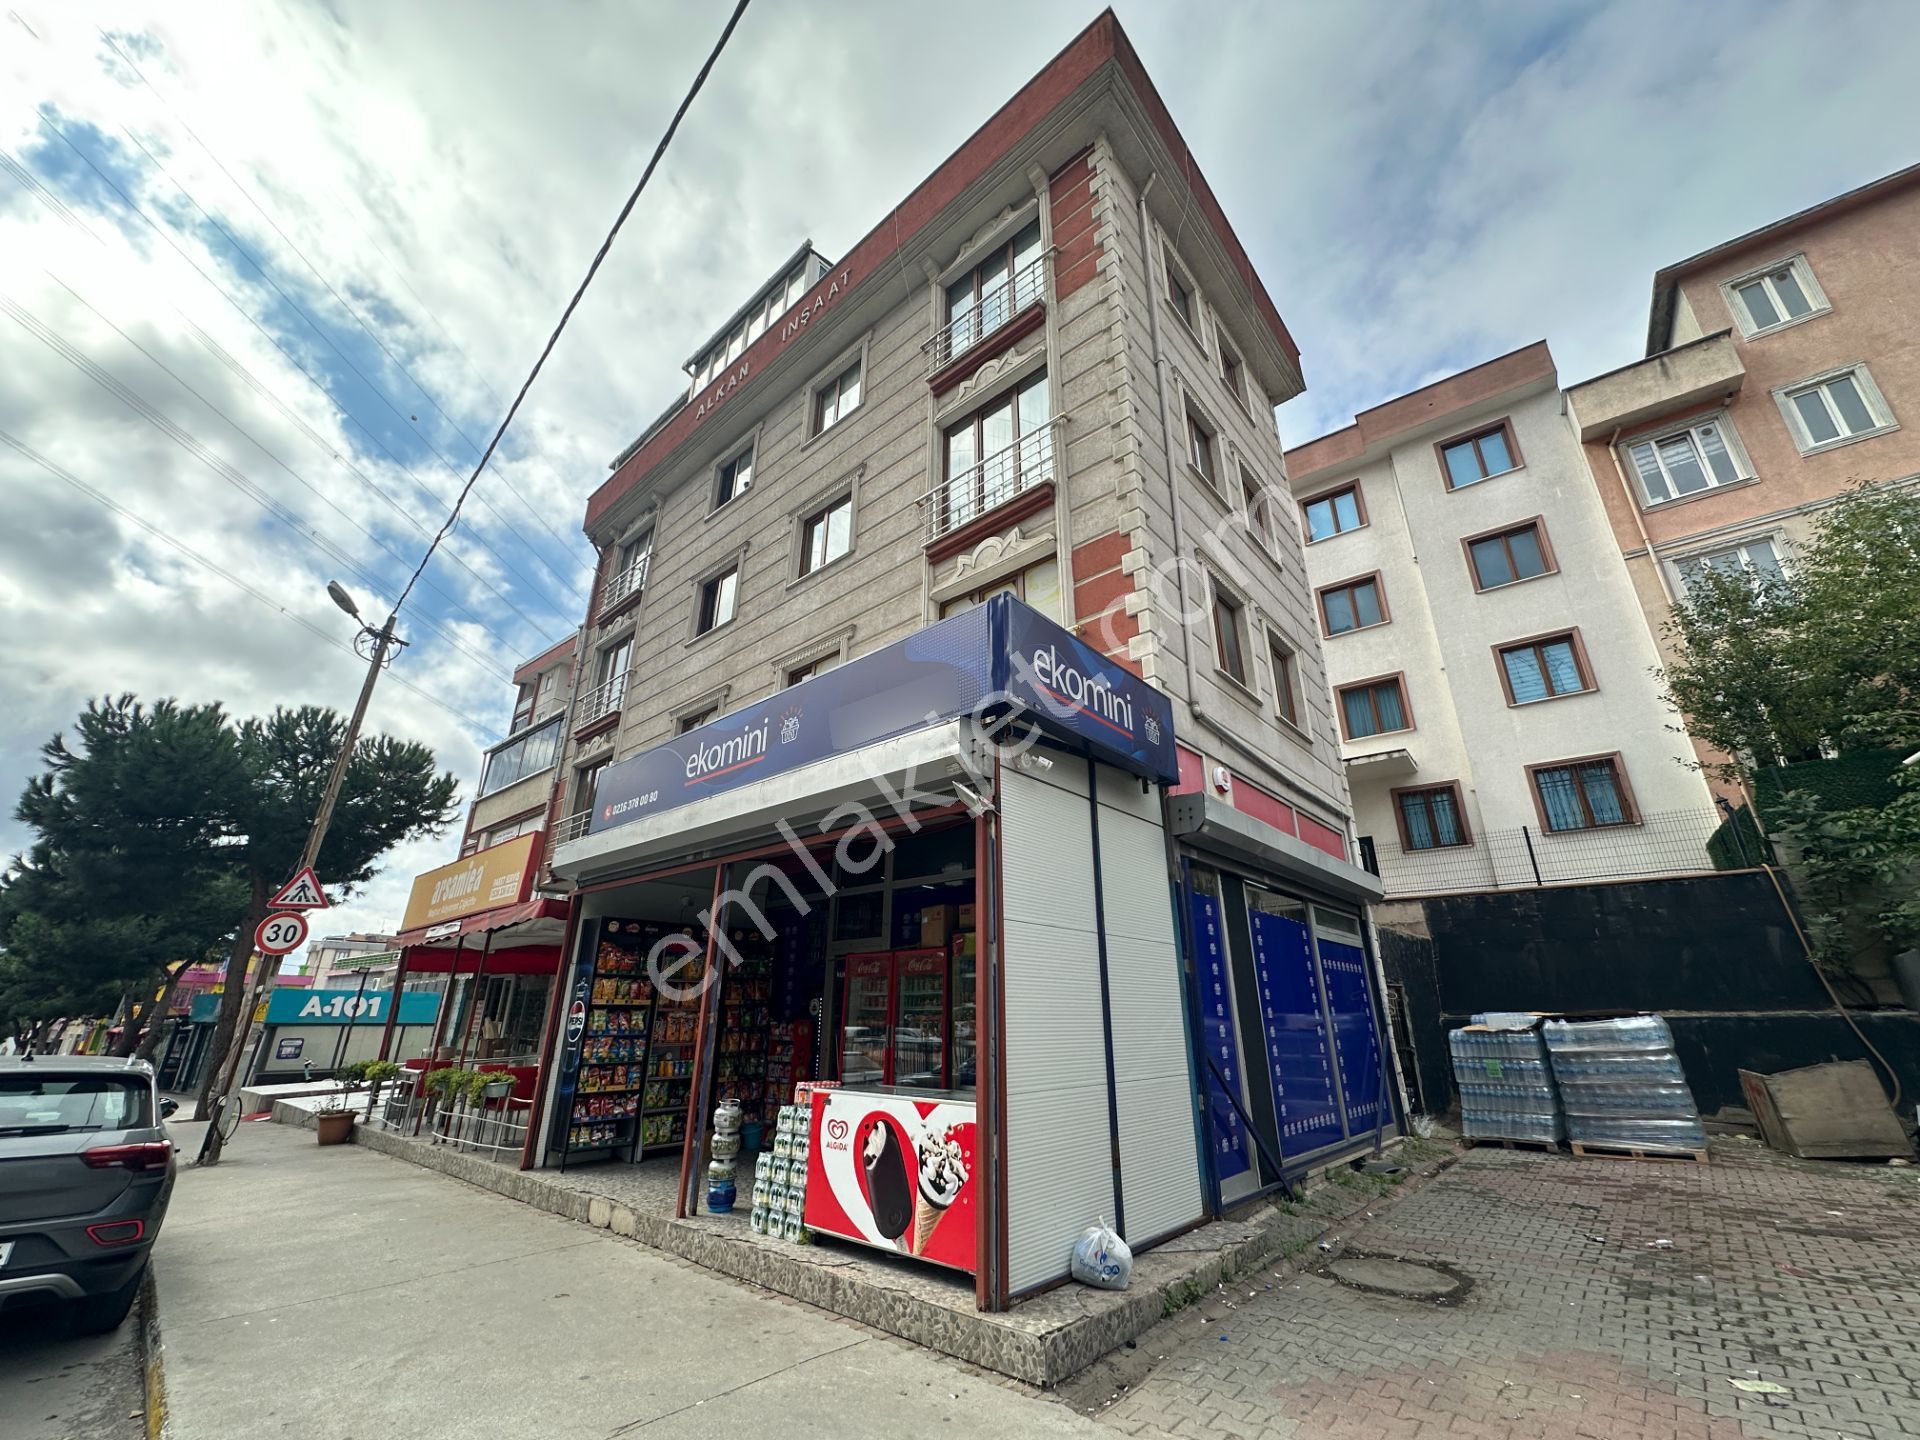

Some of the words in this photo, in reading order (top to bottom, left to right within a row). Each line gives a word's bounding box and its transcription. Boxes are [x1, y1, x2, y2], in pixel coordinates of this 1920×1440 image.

[696, 362, 749, 420] ALKAN
[1033, 644, 1134, 731] ekomini
[686, 717, 769, 778] ekomini
[612, 802, 628, 815] 0216
[266, 923, 298, 944] 30
